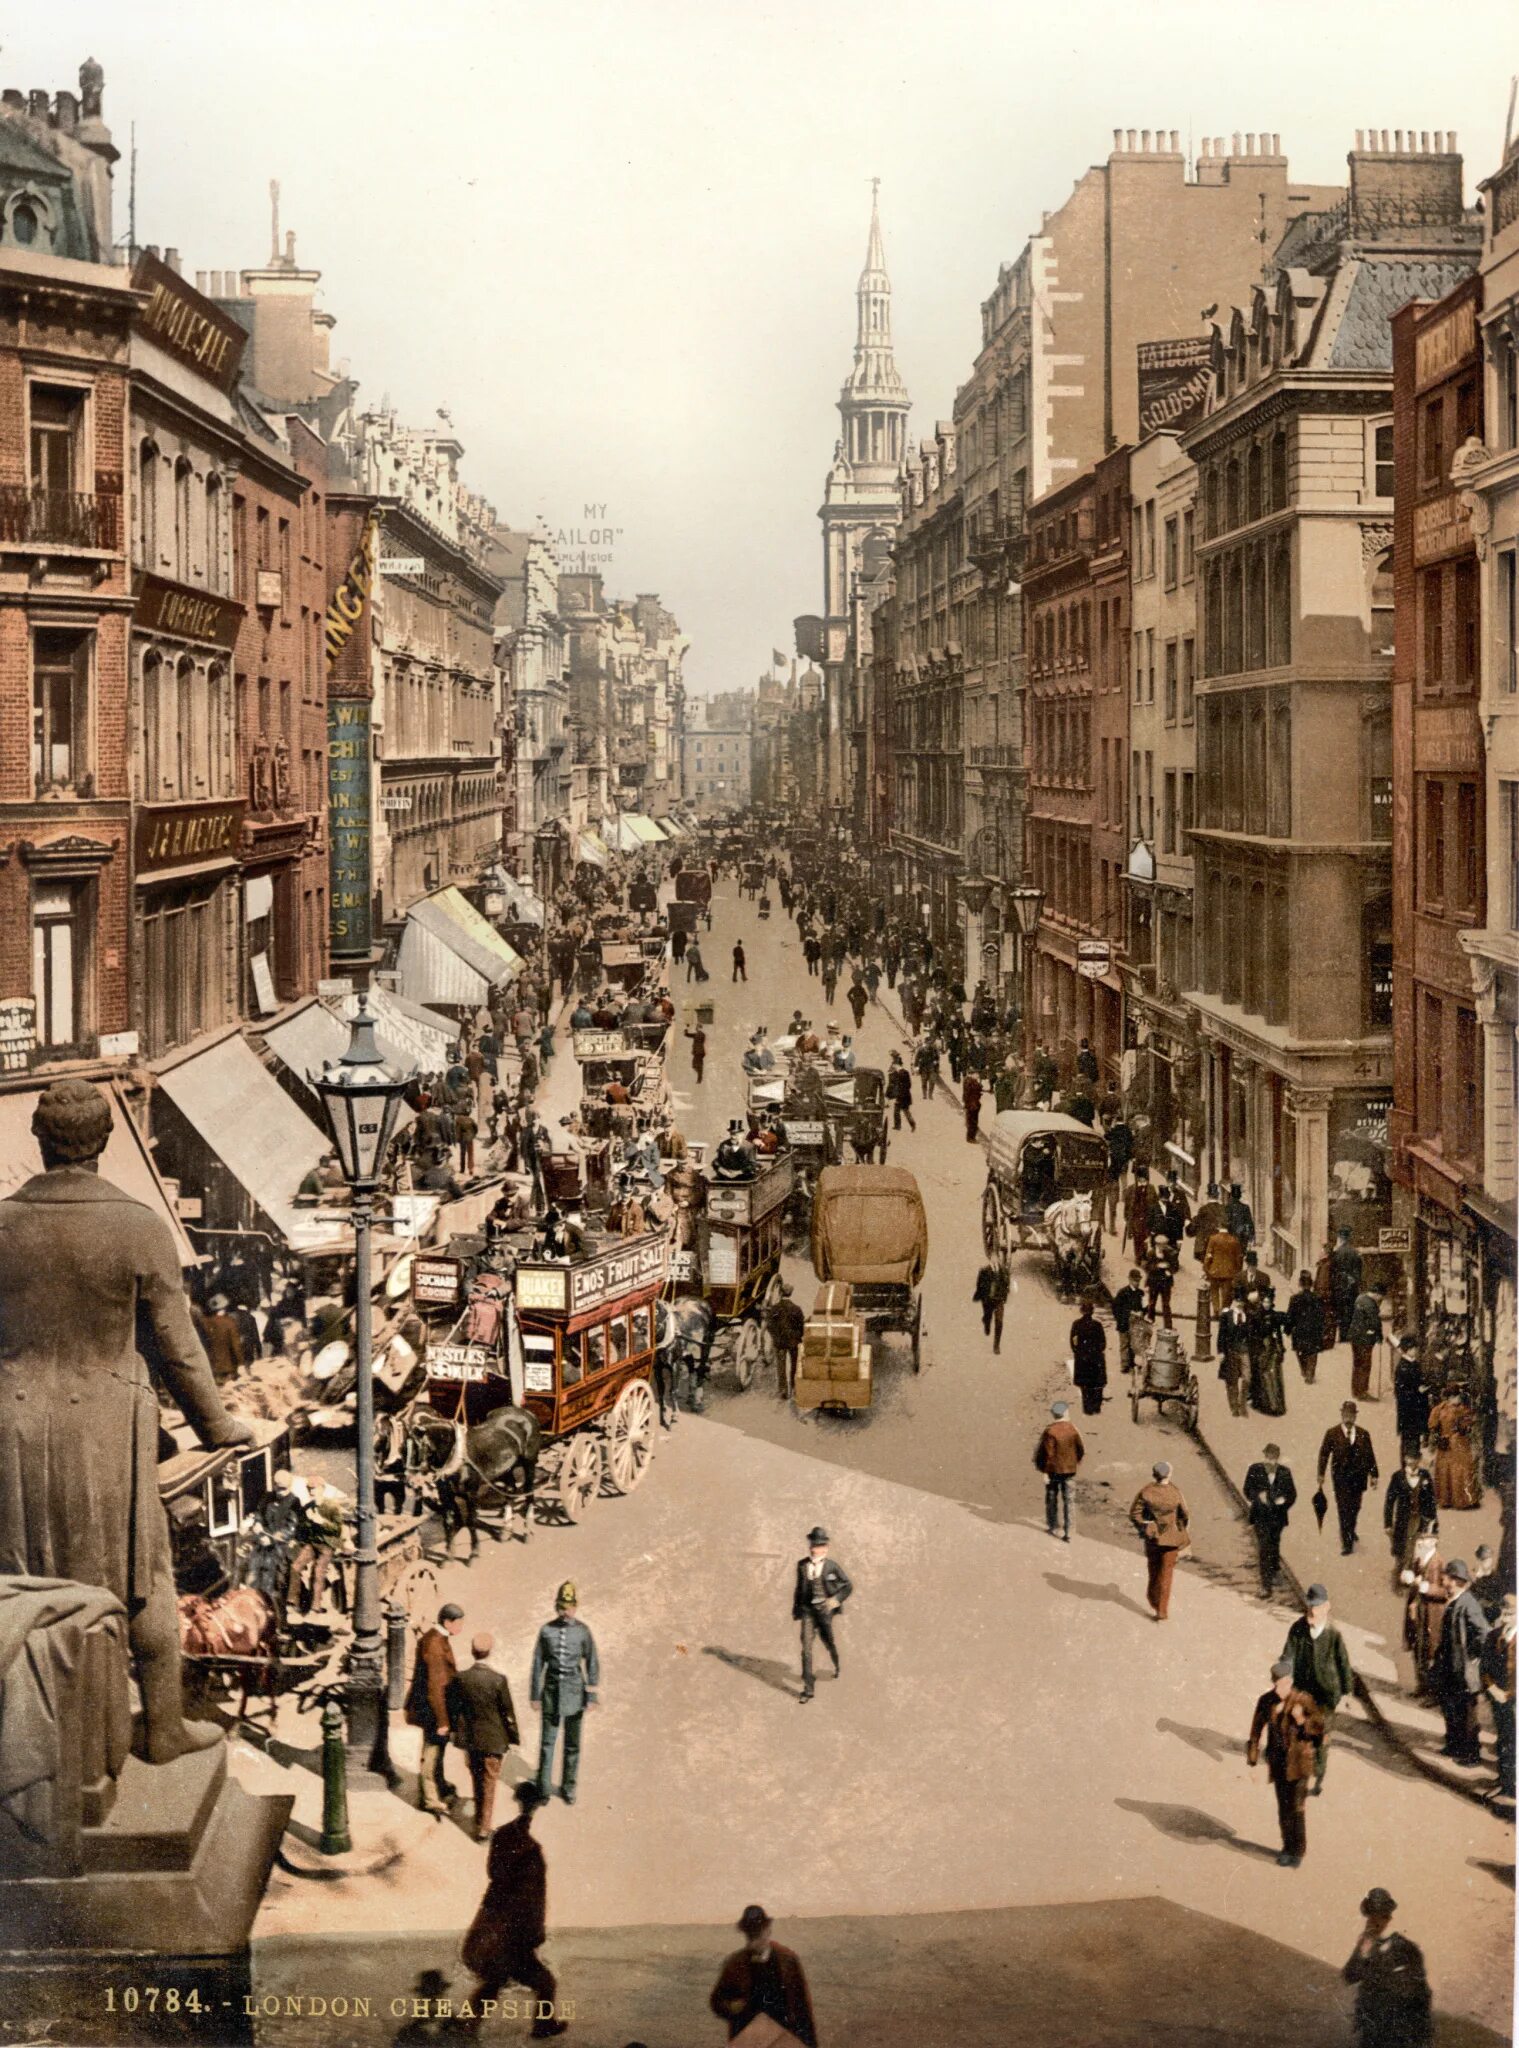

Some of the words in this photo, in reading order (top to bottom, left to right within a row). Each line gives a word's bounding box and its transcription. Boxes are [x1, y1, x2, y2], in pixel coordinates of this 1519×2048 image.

[584, 503, 608, 519] MY
[1354, 1061, 1381, 1077] 41
[605, 1254, 640, 1285] FRUIT
[639, 1243, 665, 1271] SALT
[521, 1296, 562, 1308] OATS
